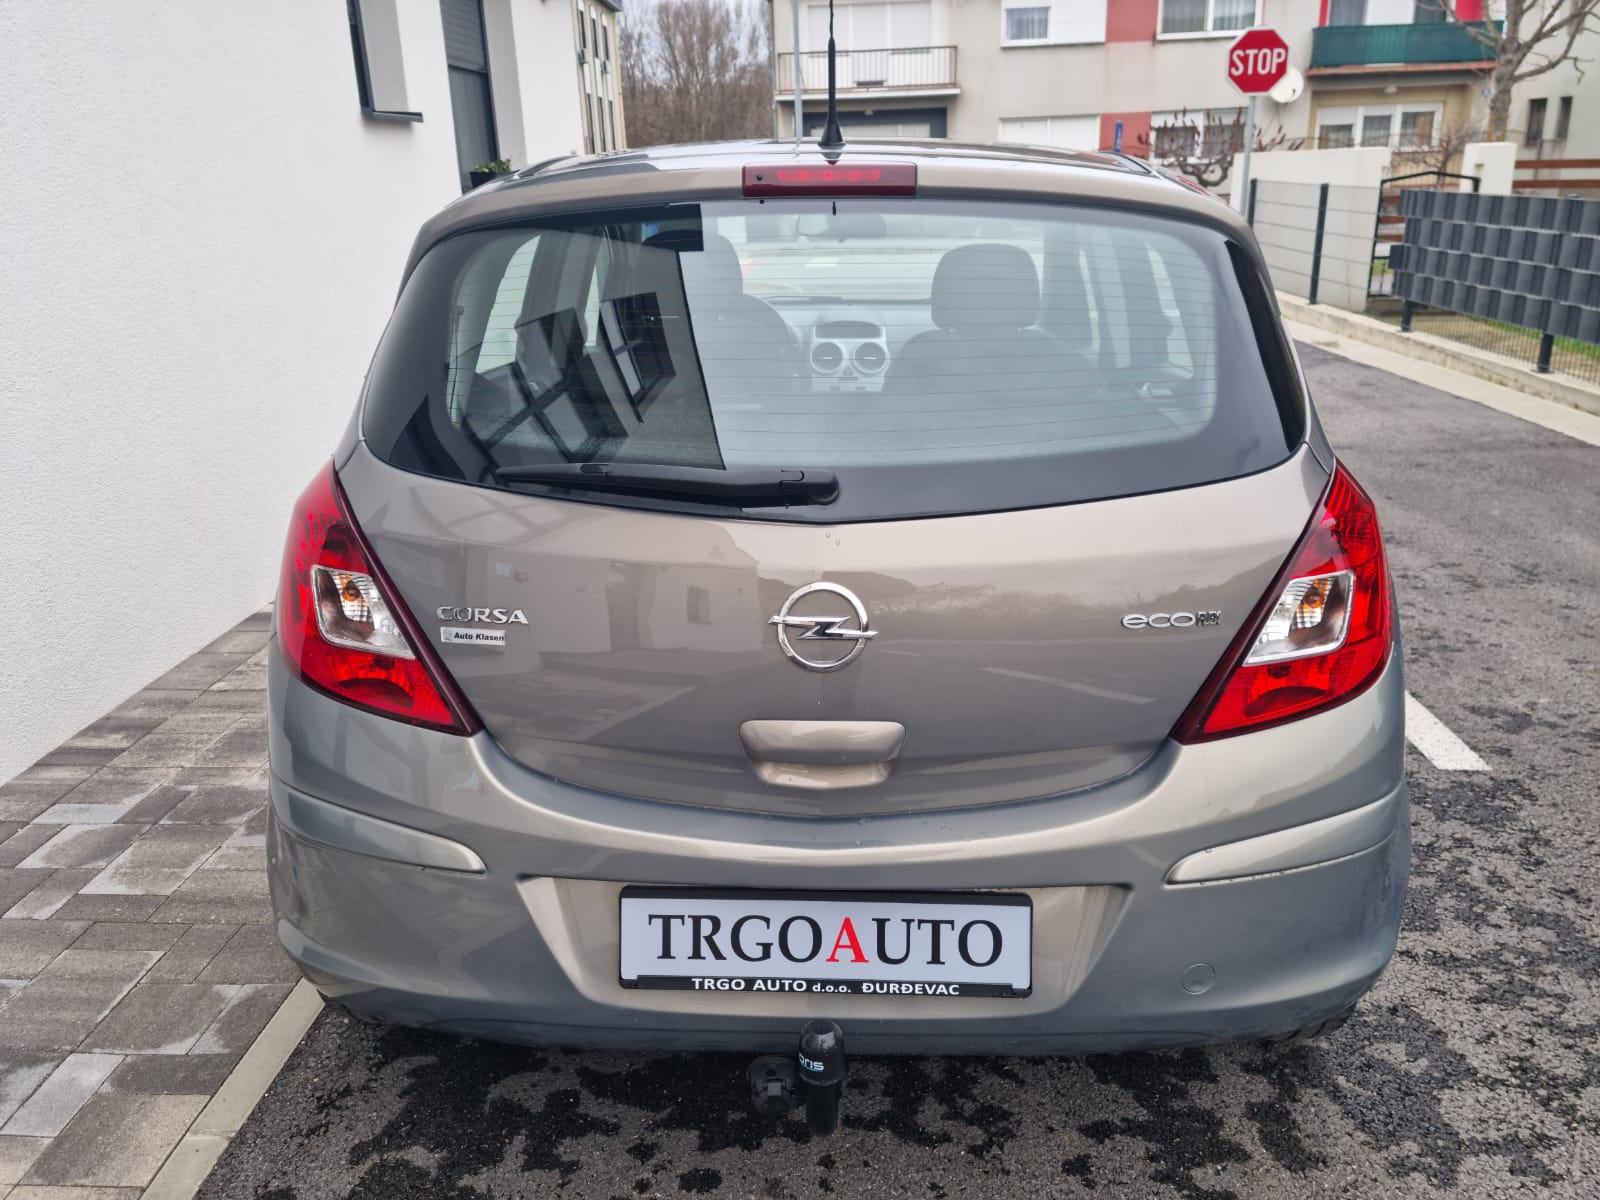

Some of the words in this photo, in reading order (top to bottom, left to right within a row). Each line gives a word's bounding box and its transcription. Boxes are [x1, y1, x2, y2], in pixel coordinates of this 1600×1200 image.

[1230, 47, 1287, 77] STOP
[437, 606, 529, 625] CORSA
[453, 631, 473, 640] Auto
[648, 914, 1003, 967] TRGOAUTO
[692, 978, 746, 991] TRGO
[752, 979, 807, 992] AUTO
[812, 983, 851, 993] d.o.o.
[862, 982, 960, 996] ĐURĐEVAC
